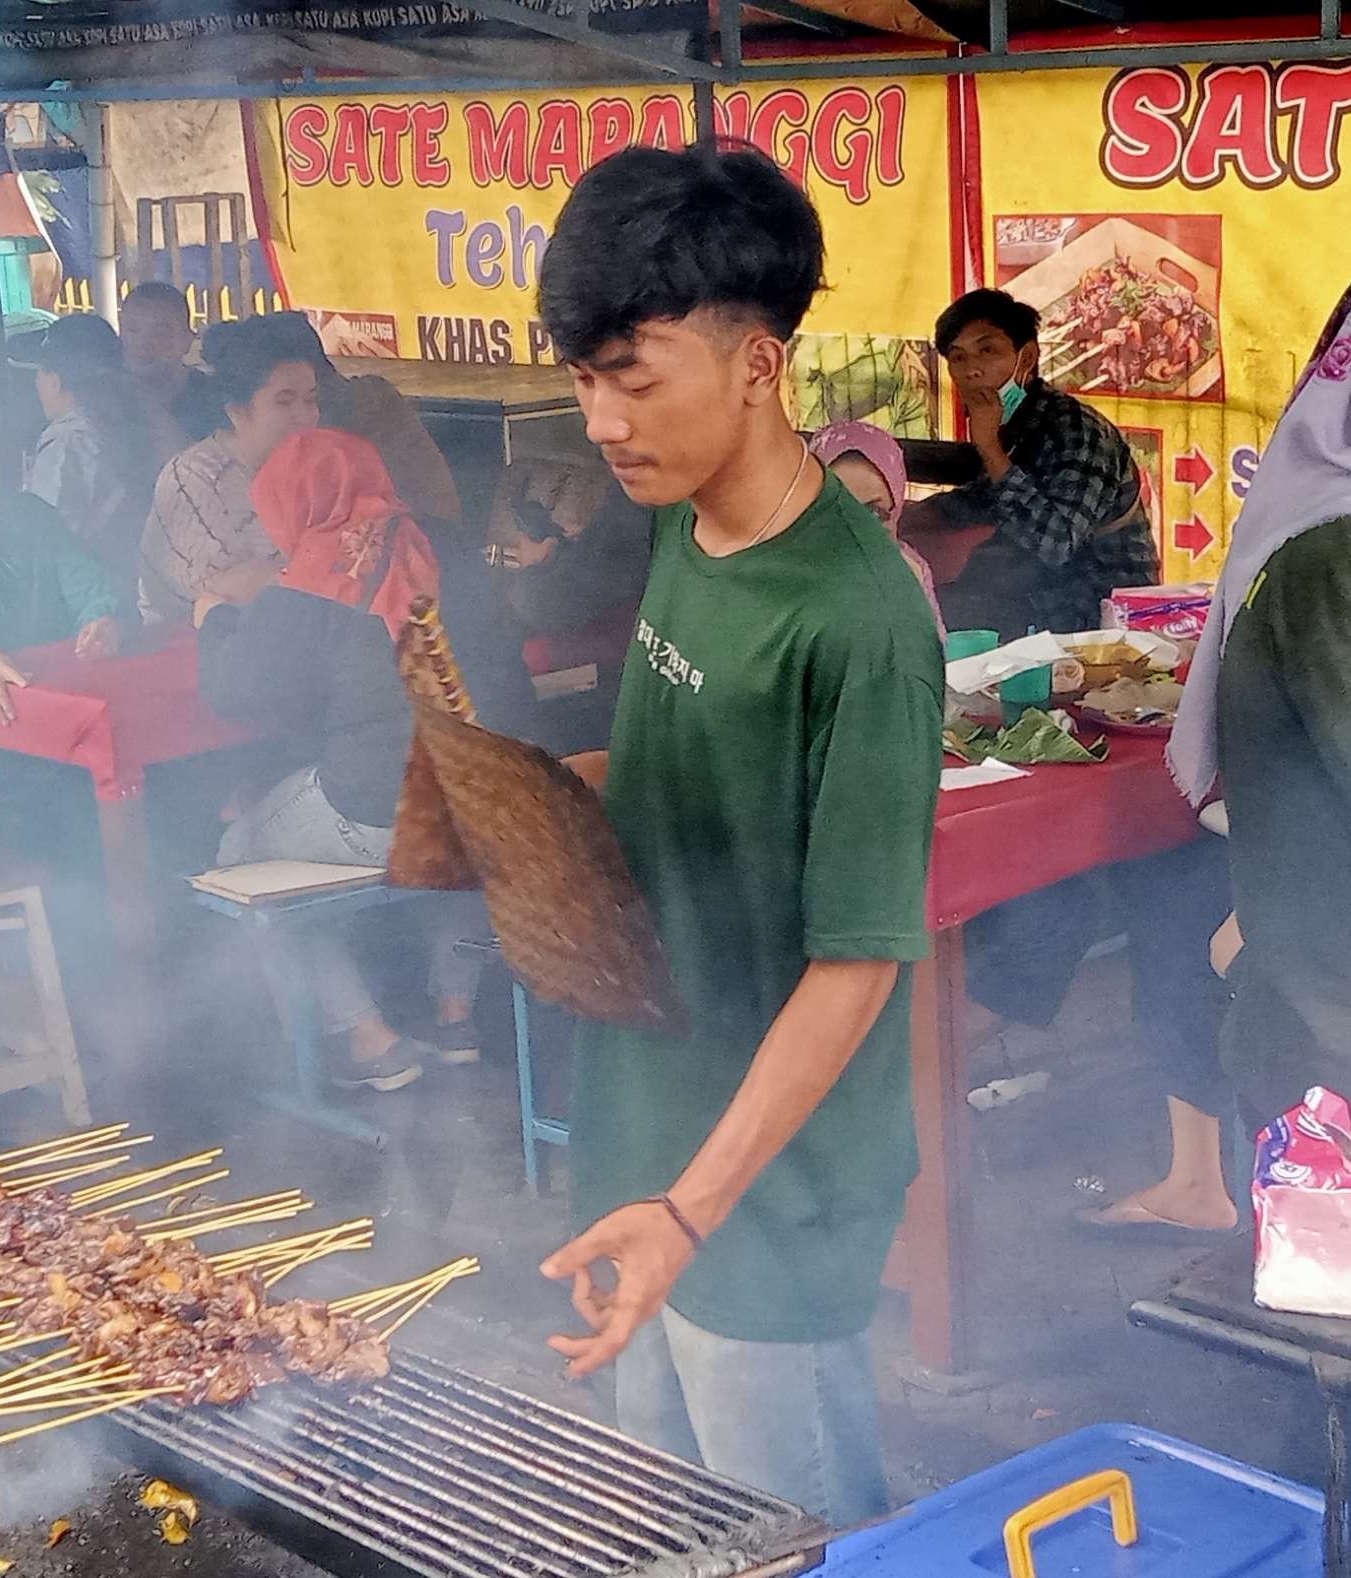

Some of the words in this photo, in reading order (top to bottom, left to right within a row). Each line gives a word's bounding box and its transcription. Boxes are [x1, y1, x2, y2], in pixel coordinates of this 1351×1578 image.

[363, 9, 397, 28] KOPI
[397, 4, 437, 26] SATU
[285, 101, 452, 189] SATE
[425, 204, 546, 292] Teh
[416, 315, 514, 366] KHAS
